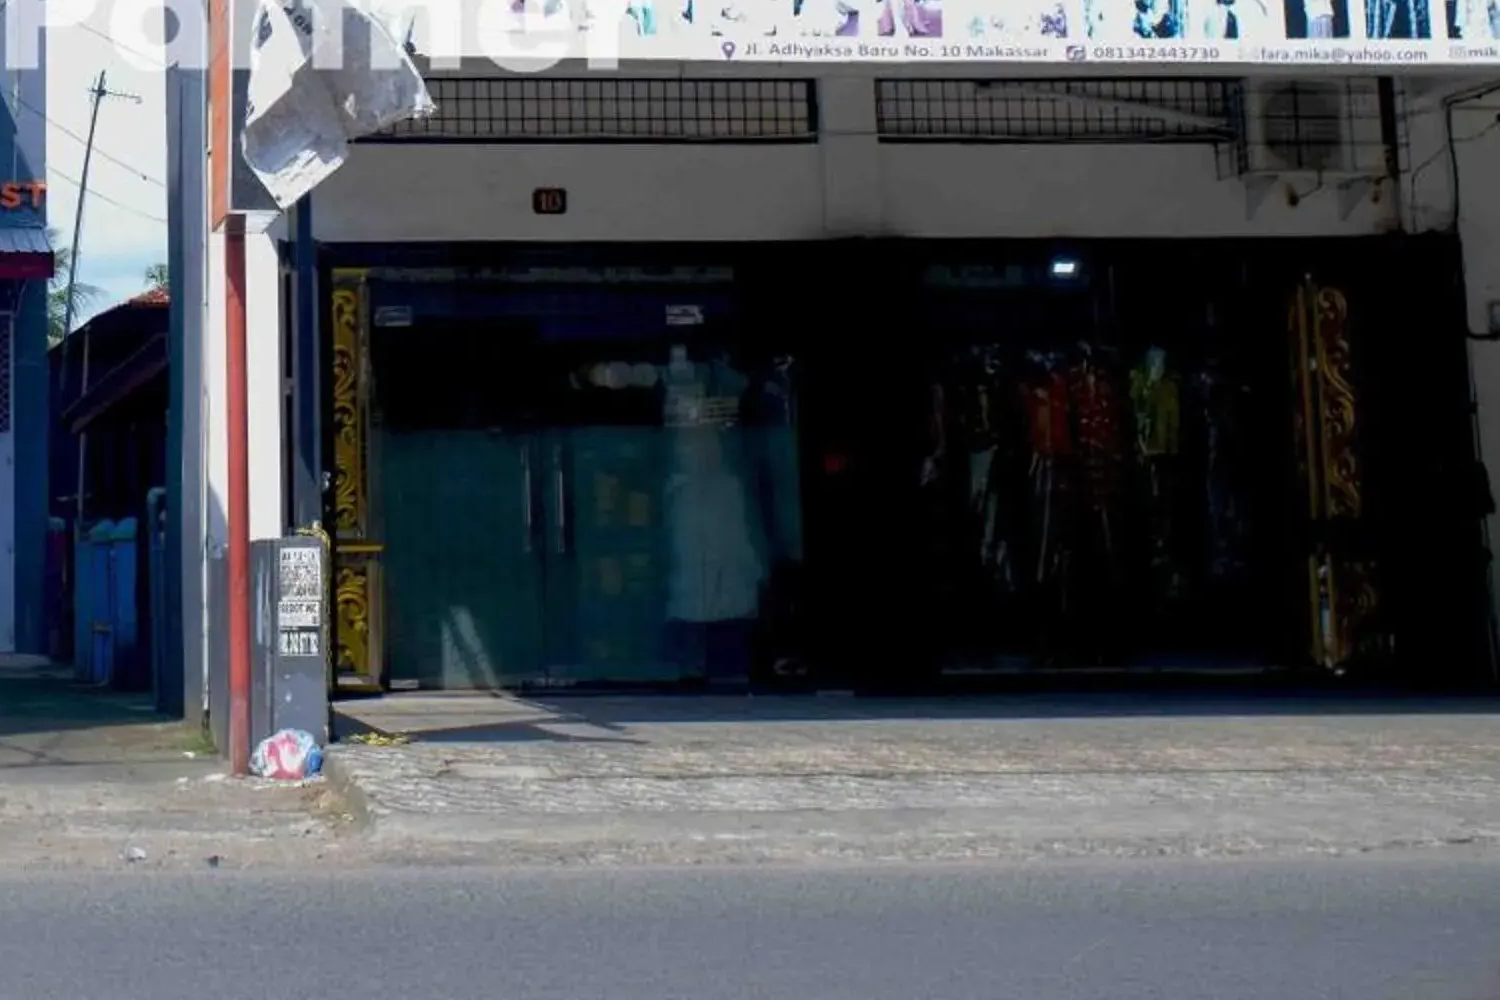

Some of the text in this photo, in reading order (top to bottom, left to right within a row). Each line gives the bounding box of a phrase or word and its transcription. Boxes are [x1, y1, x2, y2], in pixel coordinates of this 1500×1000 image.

[769, 43, 853, 59] Adhyaksa
[858, 44, 899, 57] Baru
[904, 44, 934, 57] No.
[942, 44, 961, 57] 10
[966, 43, 1049, 58] Makassar
